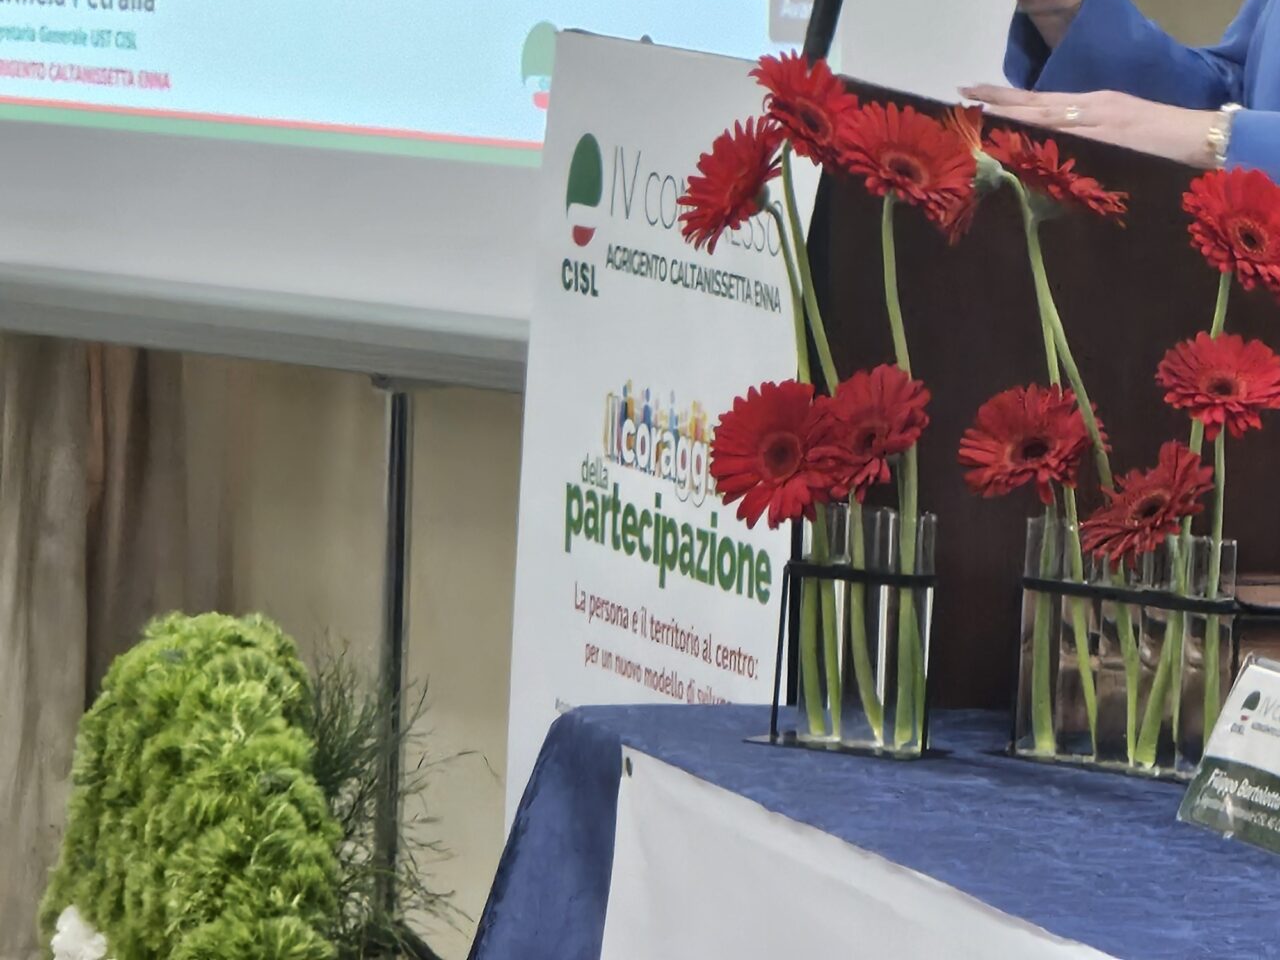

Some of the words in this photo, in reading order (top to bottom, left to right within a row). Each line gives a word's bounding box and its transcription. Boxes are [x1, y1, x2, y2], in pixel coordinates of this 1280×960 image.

[611, 146, 641, 219] IV
[561, 258, 599, 297] CISL
[606, 244, 667, 282] AGRIGENTO
[670, 259, 752, 305] CALTANISSETTA
[754, 280, 782, 313] ENNA
[581, 453, 608, 490] della
[620, 417, 718, 508] coraggi
[565, 482, 772, 605] partecipazione
[575, 581, 586, 613] La
[589, 594, 629, 630] persona
[632, 611, 638, 633] e
[640, 606, 647, 638] il
[650, 614, 699, 657] territorio
[702, 634, 712, 664] al
[716, 644, 758, 680] centro:
[585, 642, 599, 667] per
[602, 649, 612, 670] un
[615, 655, 641, 683] nuovo
[644, 666, 684, 701] modello
